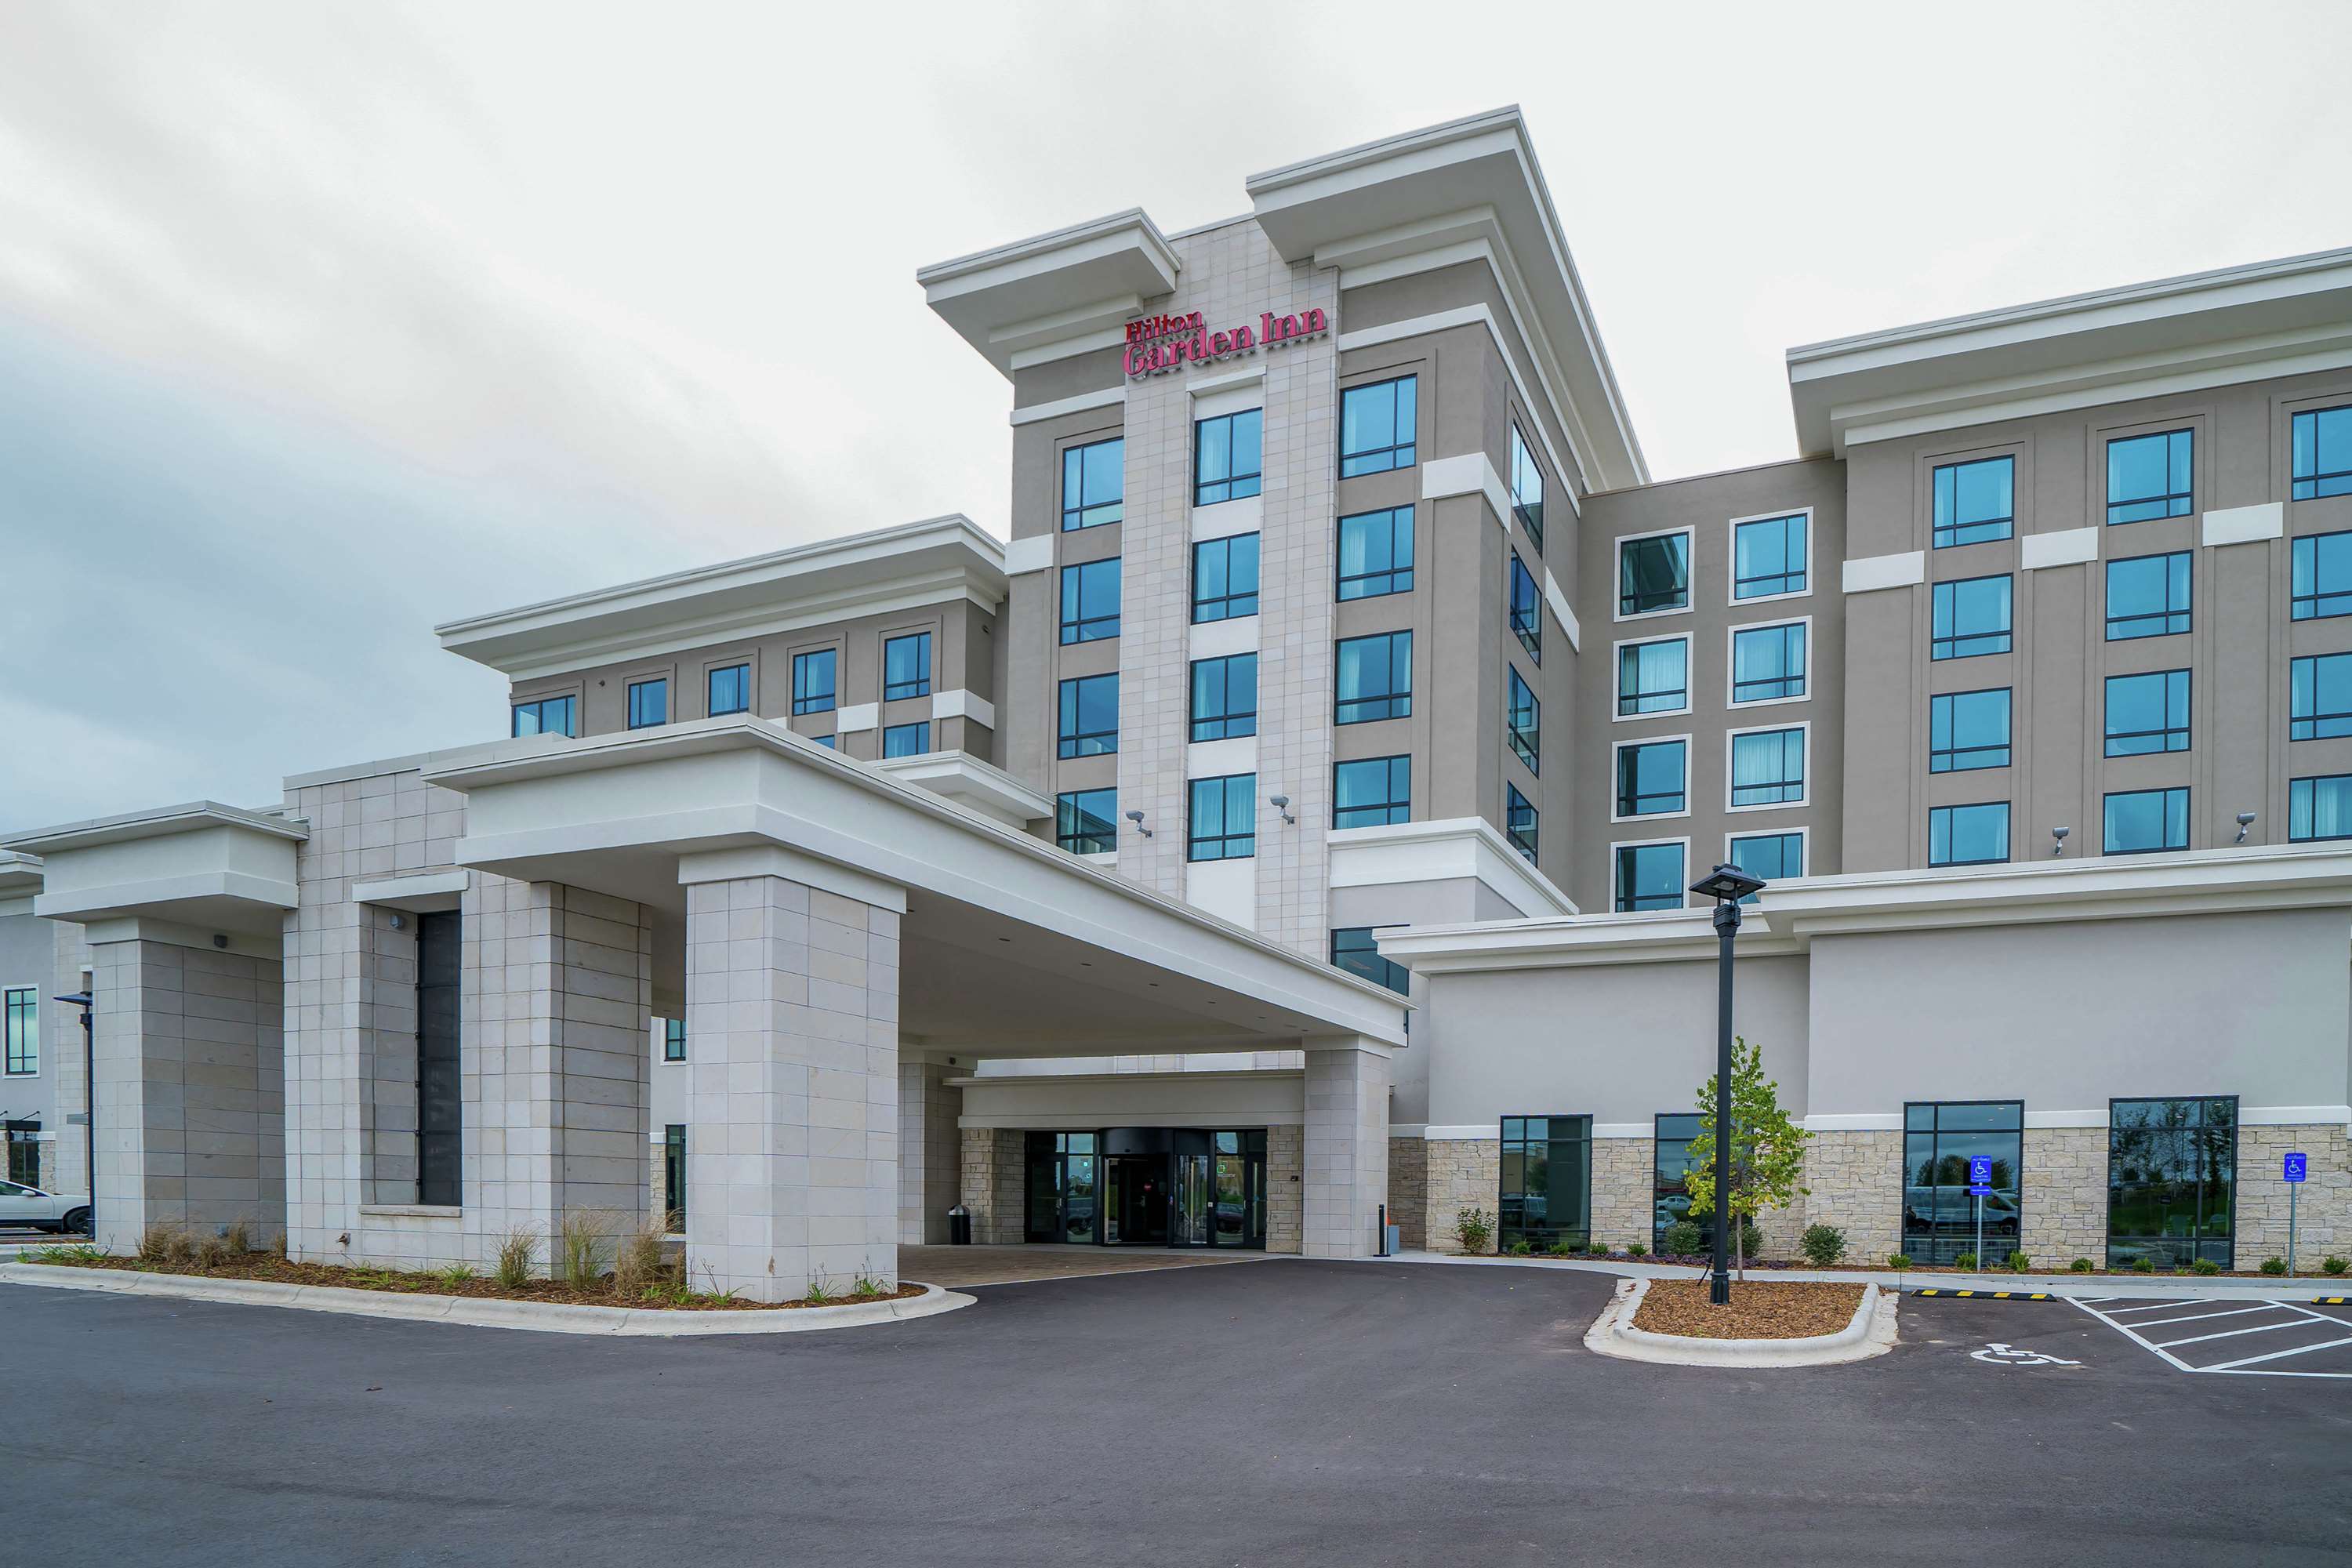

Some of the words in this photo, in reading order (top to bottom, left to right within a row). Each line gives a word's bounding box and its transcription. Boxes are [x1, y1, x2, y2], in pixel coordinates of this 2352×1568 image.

[1123, 325, 1254, 376] Garden
[1259, 307, 1327, 345] Inn
[1125, 311, 1203, 344] Hilton
